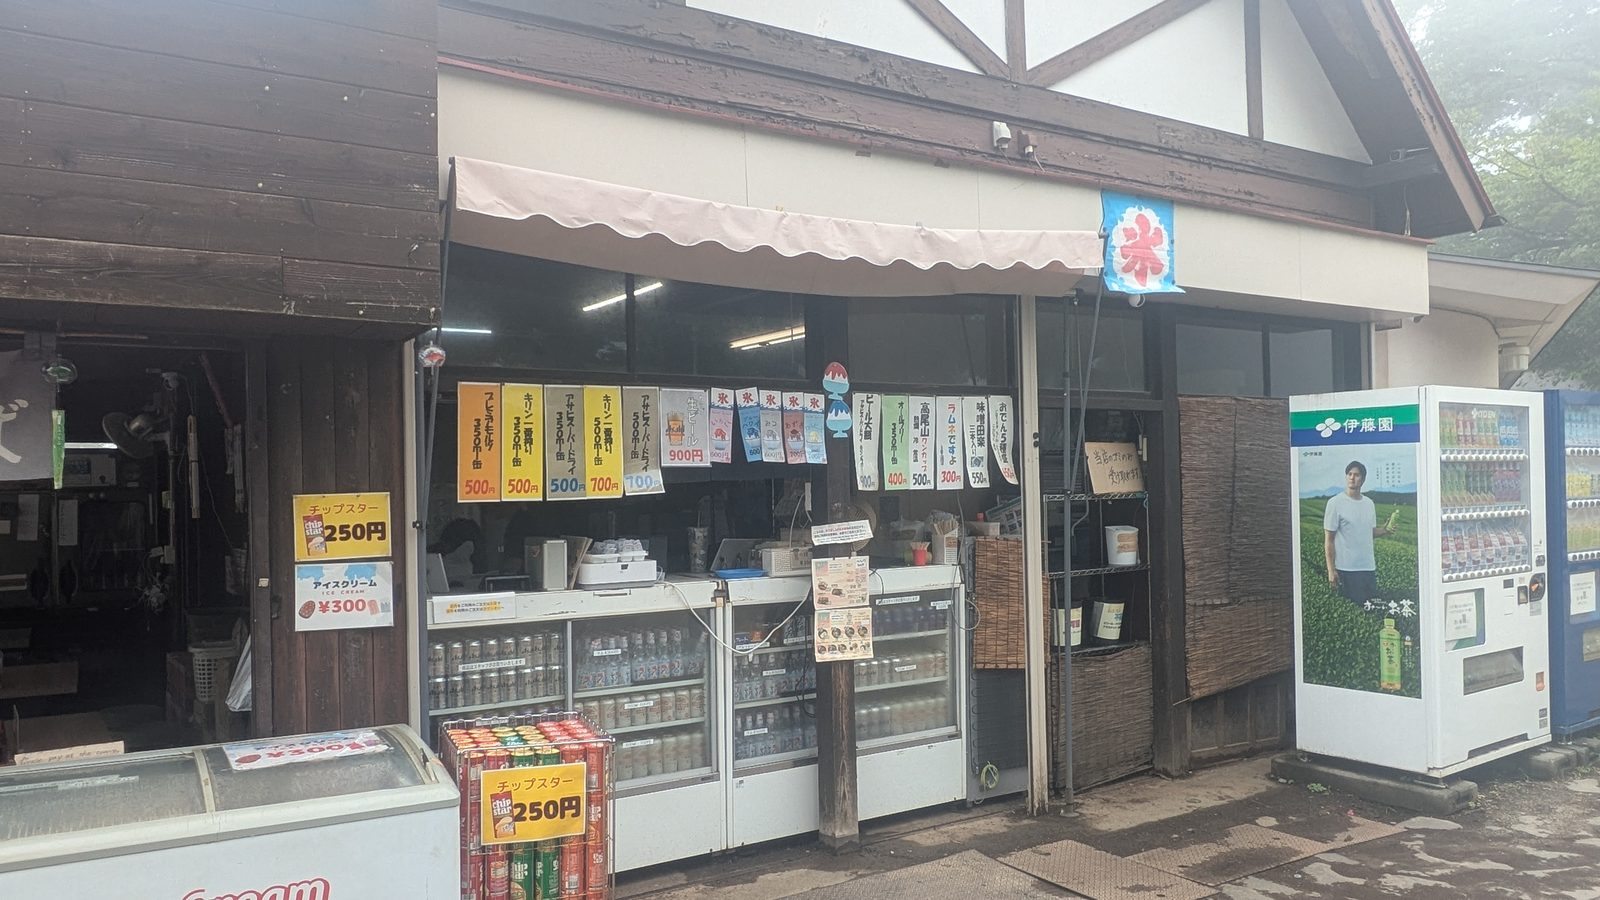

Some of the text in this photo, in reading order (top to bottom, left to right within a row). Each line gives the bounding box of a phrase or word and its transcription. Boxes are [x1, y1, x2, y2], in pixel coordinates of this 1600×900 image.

[1120, 213, 1164, 287] 氷
[717, 392, 729, 405] 氷
[742, 391, 754, 404] 氷
[765, 393, 776, 406] 氷
[788, 395, 800, 407] 氷
[810, 397, 821, 409] 氷
[523, 392, 534, 455] キリン一番搾り
[602, 393, 613, 454] キリン一番搾り
[686, 396, 699, 448] 生ビール
[976, 401, 986, 448] 味噌田楽
[1343, 417, 1394, 434] 伊藤園
[565, 393, 576, 475] アサヒスーパードライ
[640, 394, 651, 473] アサヒスーパードライ
[947, 403, 957, 466] ラムネですよ
[669, 449, 704, 461] 900円
[888, 472, 908, 486] 400円
[912, 473, 932, 486] 500円
[940, 470, 962, 483] 300円
[465, 479, 496, 494] 500円
[507, 479, 539, 494] 500円
[550, 478, 586, 493] 500円
[590, 477, 619, 492] 700円
[309, 503, 379, 515] チップスター
[324, 521, 387, 542] 250円
[313, 580, 377, 590] アイスクリーム
[319, 599, 367, 614] ¥300
[497, 777, 573, 793] チップスター
[492, 798, 512, 811] chip
[492, 806, 513, 817] star
[514, 796, 581, 822] 250円
